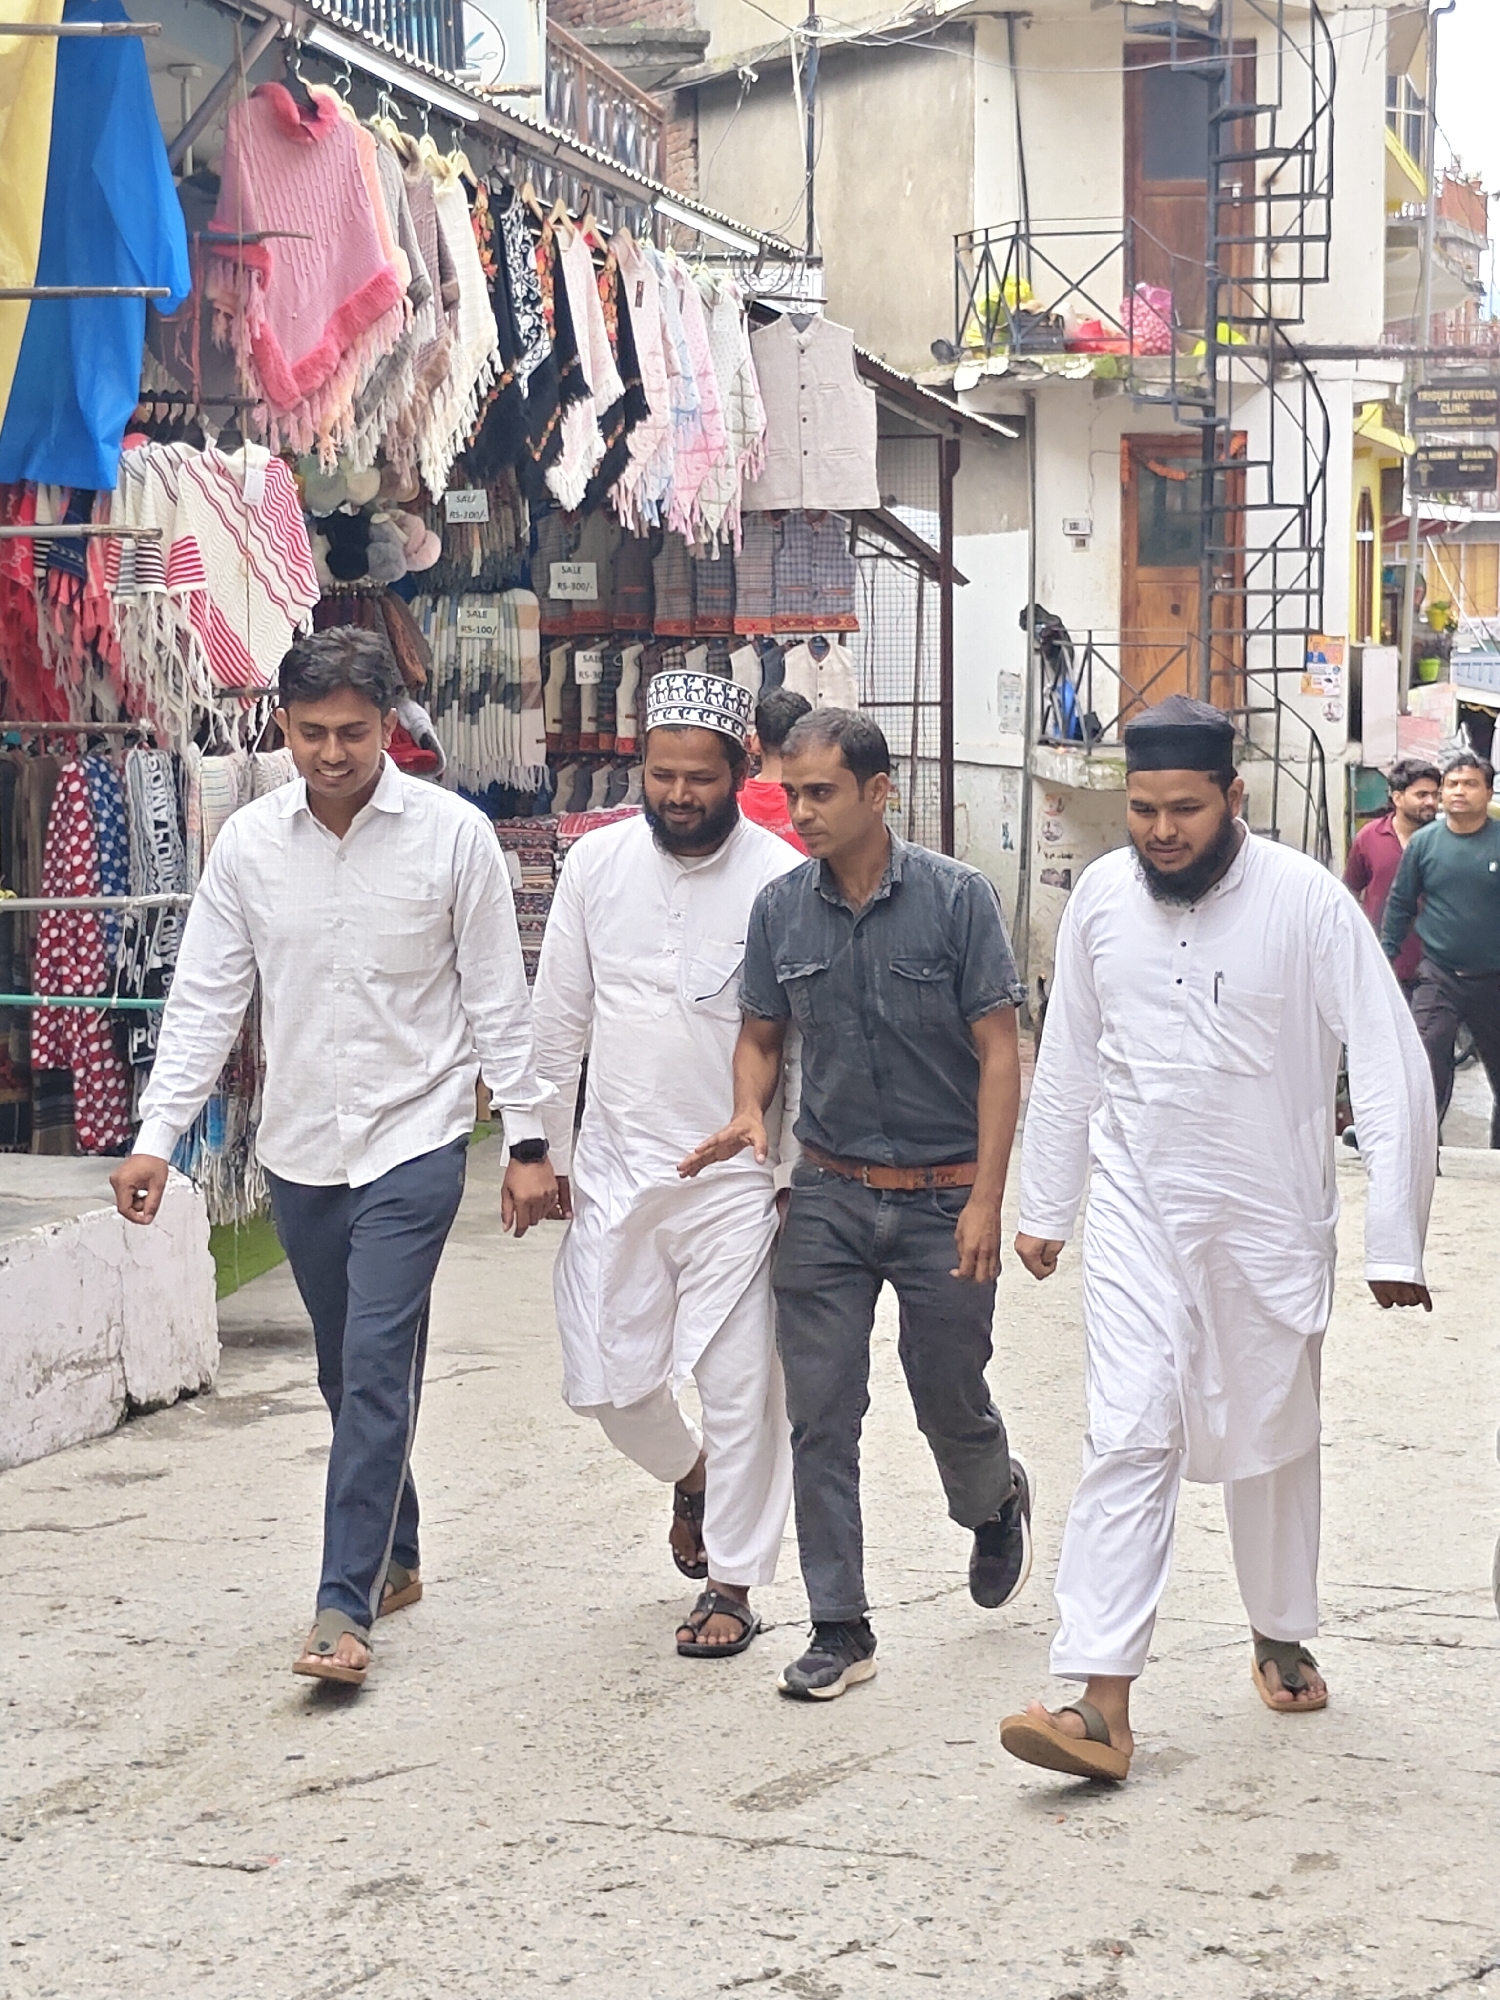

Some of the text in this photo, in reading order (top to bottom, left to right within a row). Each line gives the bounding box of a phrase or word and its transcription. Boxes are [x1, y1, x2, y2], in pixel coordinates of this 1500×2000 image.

[1452, 389, 1498, 401] AYURVEDA
[1440, 402, 1470, 414] CLINIC
[561, 565, 581, 575] SALE
[466, 610, 488, 619] SALE
